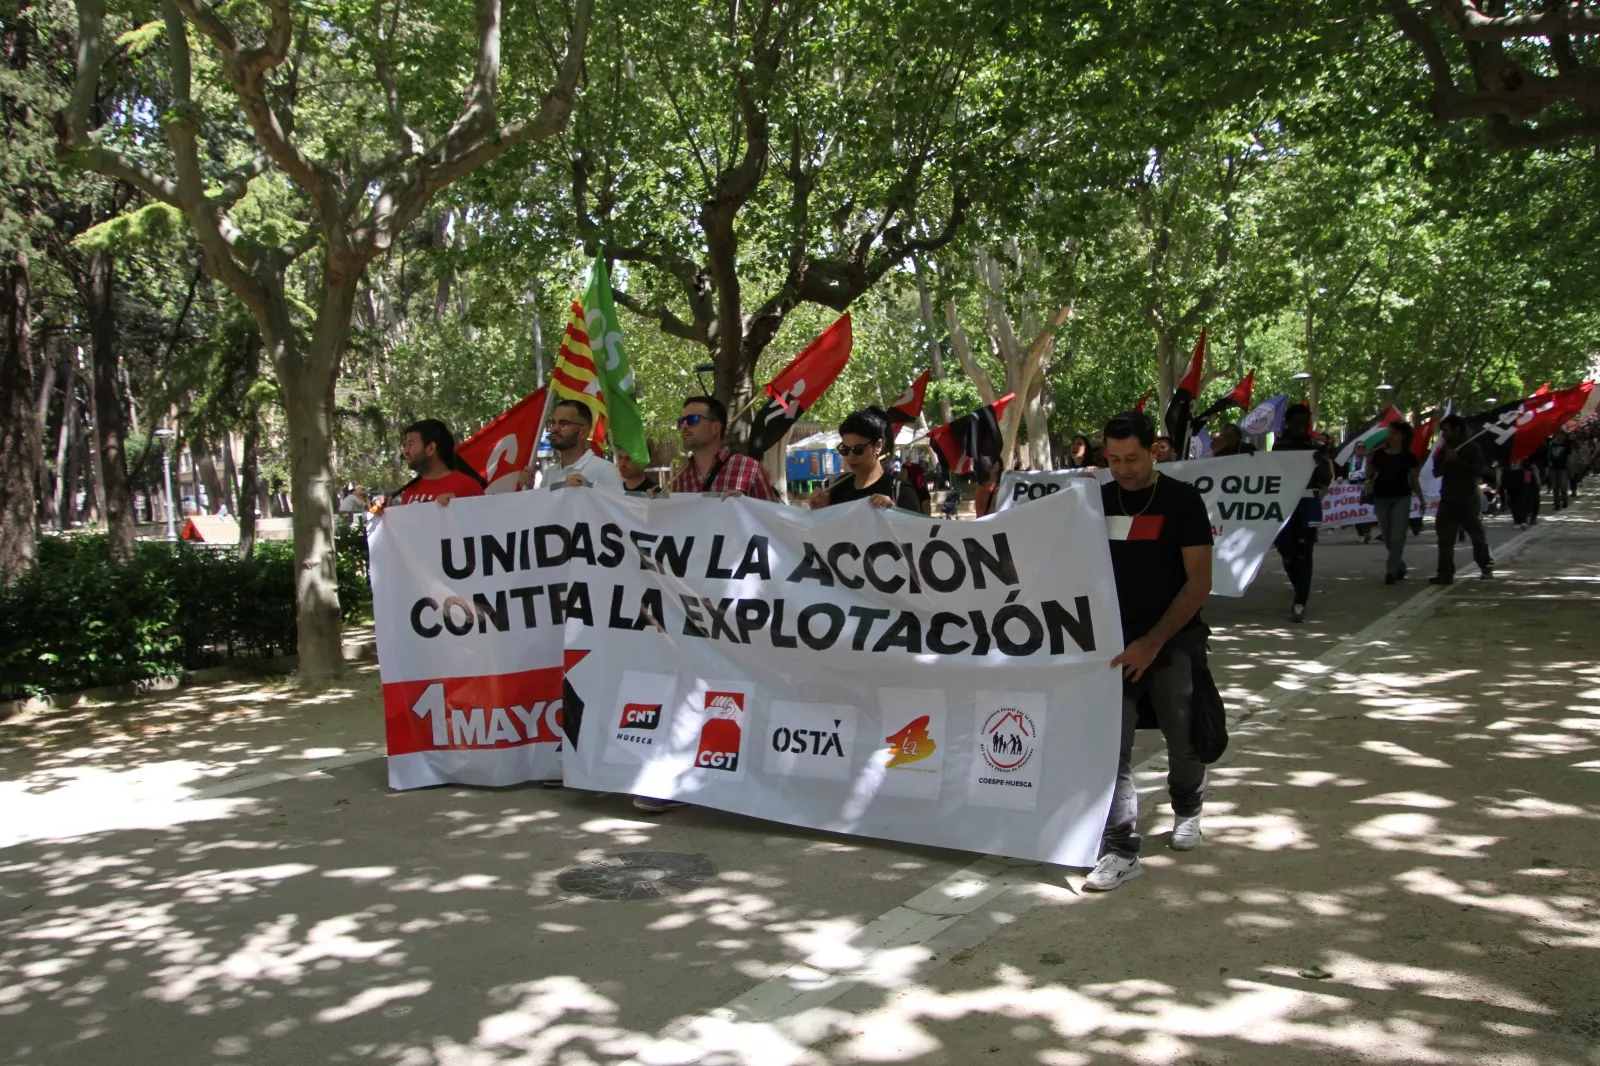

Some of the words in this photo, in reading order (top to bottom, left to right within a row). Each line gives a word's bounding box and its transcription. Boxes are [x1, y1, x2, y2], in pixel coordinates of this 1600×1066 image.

[1221, 475, 1281, 494] QUE
[1217, 502, 1284, 522] VIDA
[440, 522, 625, 580] UNIDAS
[630, 530, 695, 578] EN
[705, 534, 771, 580] LA
[786, 524, 1020, 595] ACCIÓN
[608, 584, 667, 633] LA
[679, 590, 1096, 657] EXPLOTACIÓN
[411, 683, 449, 747] 1
[627, 710, 656, 723] CNT
[616, 733, 653, 745] HUESCA
[698, 750, 737, 769] CGT
[978, 777, 1032, 788] COESPE-HUESCA
